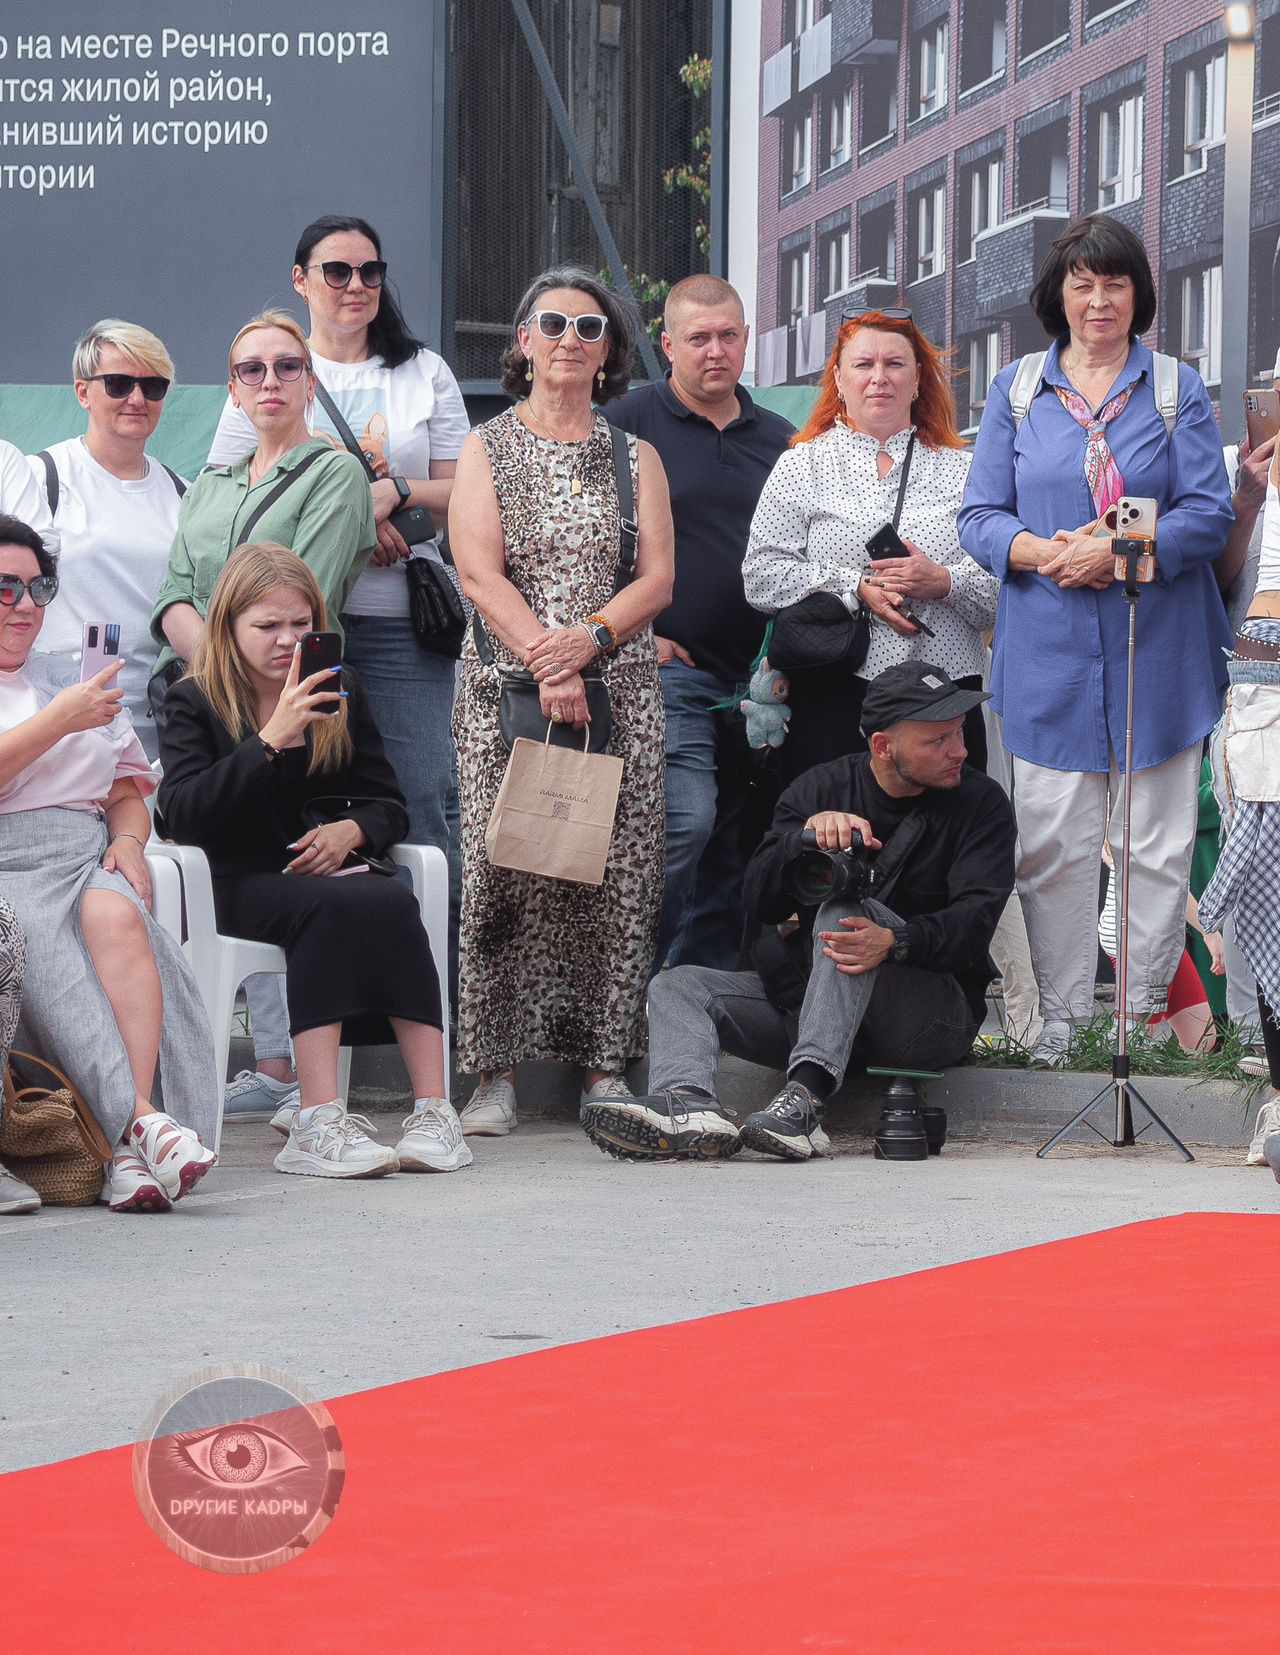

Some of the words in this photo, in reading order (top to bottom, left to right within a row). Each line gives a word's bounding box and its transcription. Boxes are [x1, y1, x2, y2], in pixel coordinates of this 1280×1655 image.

[16, 35, 53, 59] на
[60, 34, 153, 59] месте
[162, 28, 289, 58] Речного
[298, 31, 390, 64] порта
[0, 78, 54, 103] тся
[60, 69, 160, 102] жилой
[169, 69, 272, 109] район,
[0, 113, 123, 146] нивший
[132, 120, 268, 153] историю
[0, 164, 95, 196] тории
